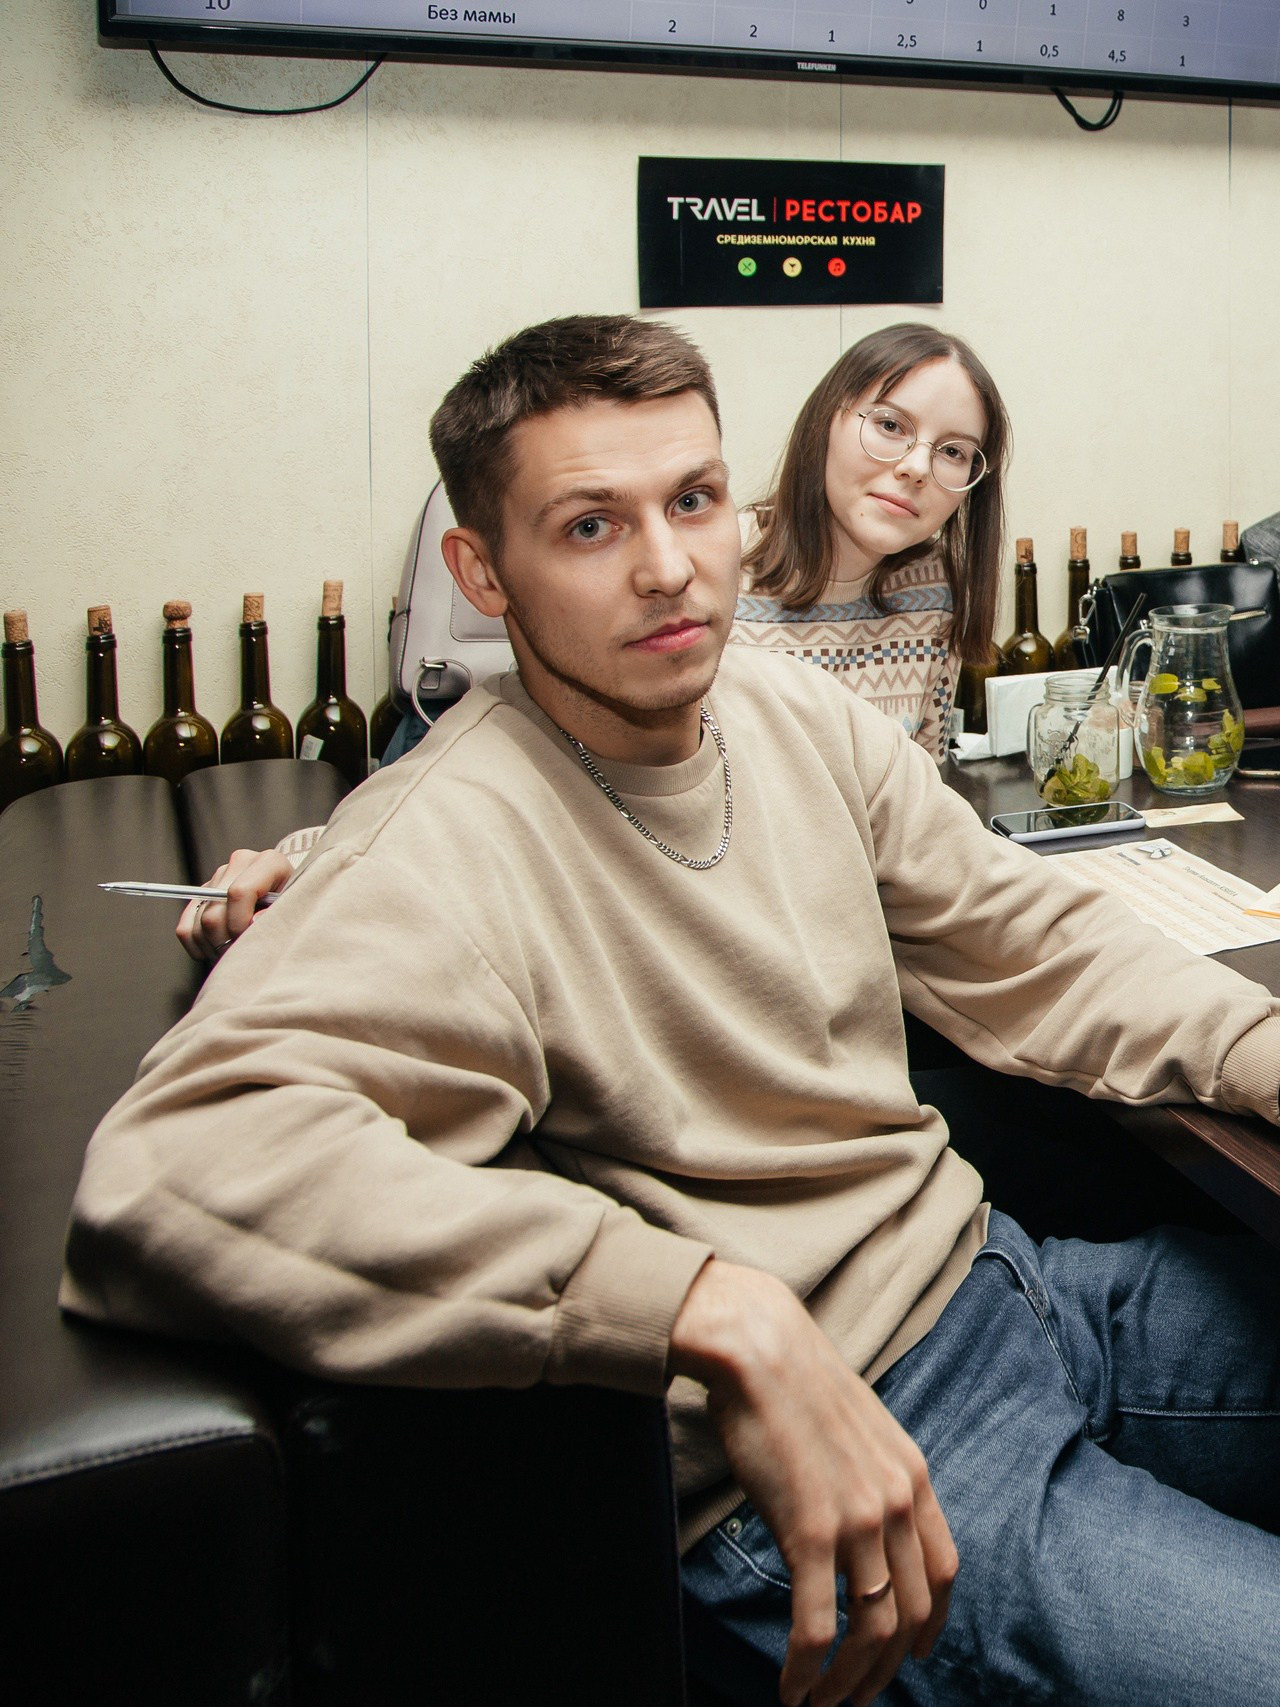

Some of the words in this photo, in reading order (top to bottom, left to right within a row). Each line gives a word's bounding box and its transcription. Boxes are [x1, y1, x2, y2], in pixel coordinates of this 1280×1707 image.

[1050, 3, 1057, 16] 1
[1117, 9, 1125, 22] 8
[1182, 15, 1190, 28] 3
[427, 4, 458, 21] Без
[463, 9, 516, 24] мамы
[668, 19, 677, 33] 2
[749, 24, 758, 38] 2
[828, 29, 835, 43] 1
[897, 33, 917, 49] 2,5
[976, 39, 983, 53] 1
[1039, 44, 1059, 59] 0,5
[1107, 49, 1127, 63] 4,5
[1179, 54, 1185, 68] 1
[796, 61, 837, 72] TELEFUNKEN
[666, 196, 766, 222] TRAVEL
[784, 198, 923, 224] РЕСТОБАР
[716, 234, 838, 246] СРЕДИЗЕМНОМОРСКАЯ
[842, 235, 876, 246] КУХНЯ
